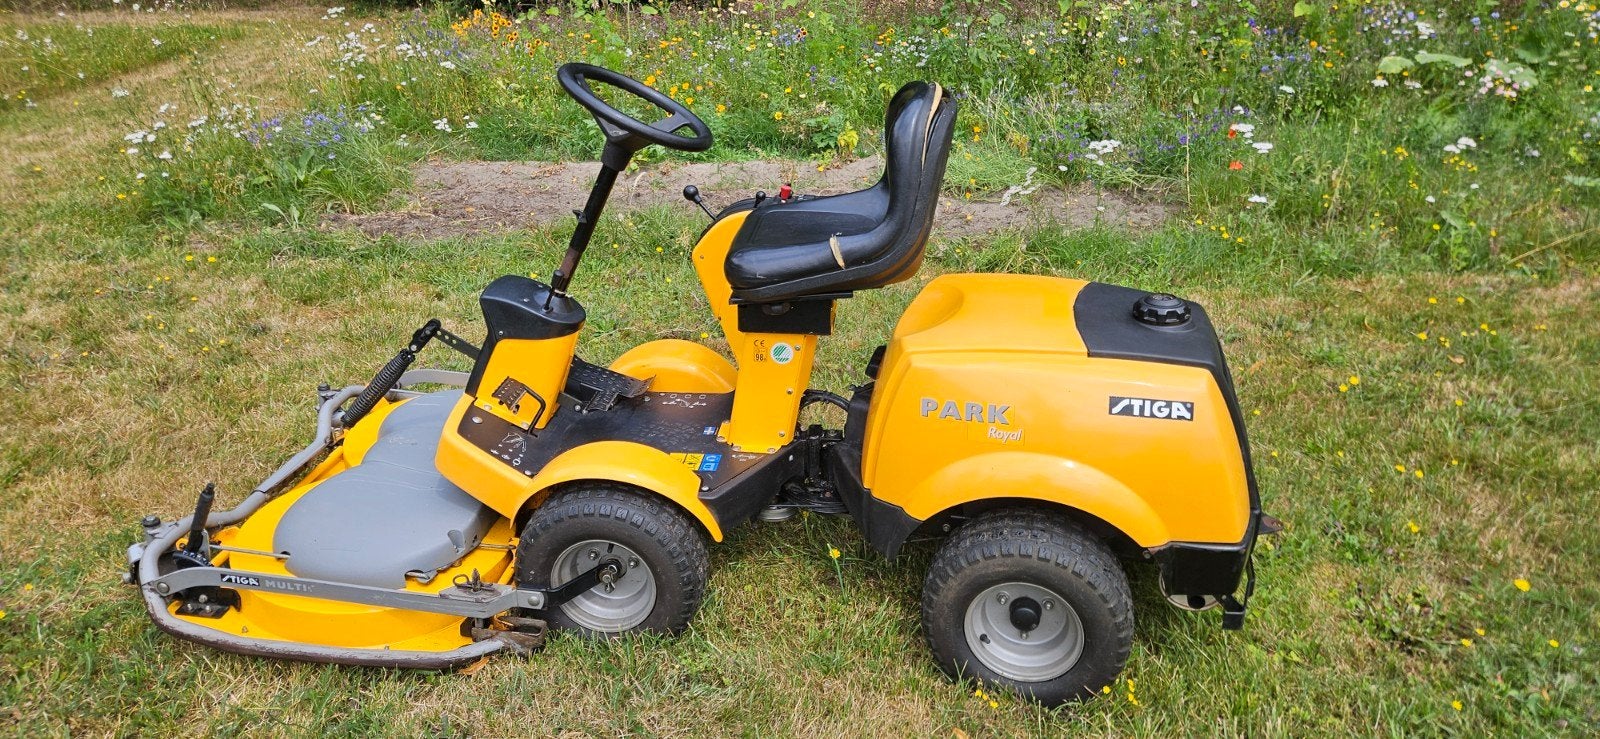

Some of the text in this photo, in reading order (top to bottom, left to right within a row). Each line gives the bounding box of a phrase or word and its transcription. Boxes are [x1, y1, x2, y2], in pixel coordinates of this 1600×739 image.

[920, 397, 1011, 426] PARK
[1110, 397, 1192, 420] STIGA
[988, 426, 1023, 445] Royal
[222, 574, 259, 587] STIGA
